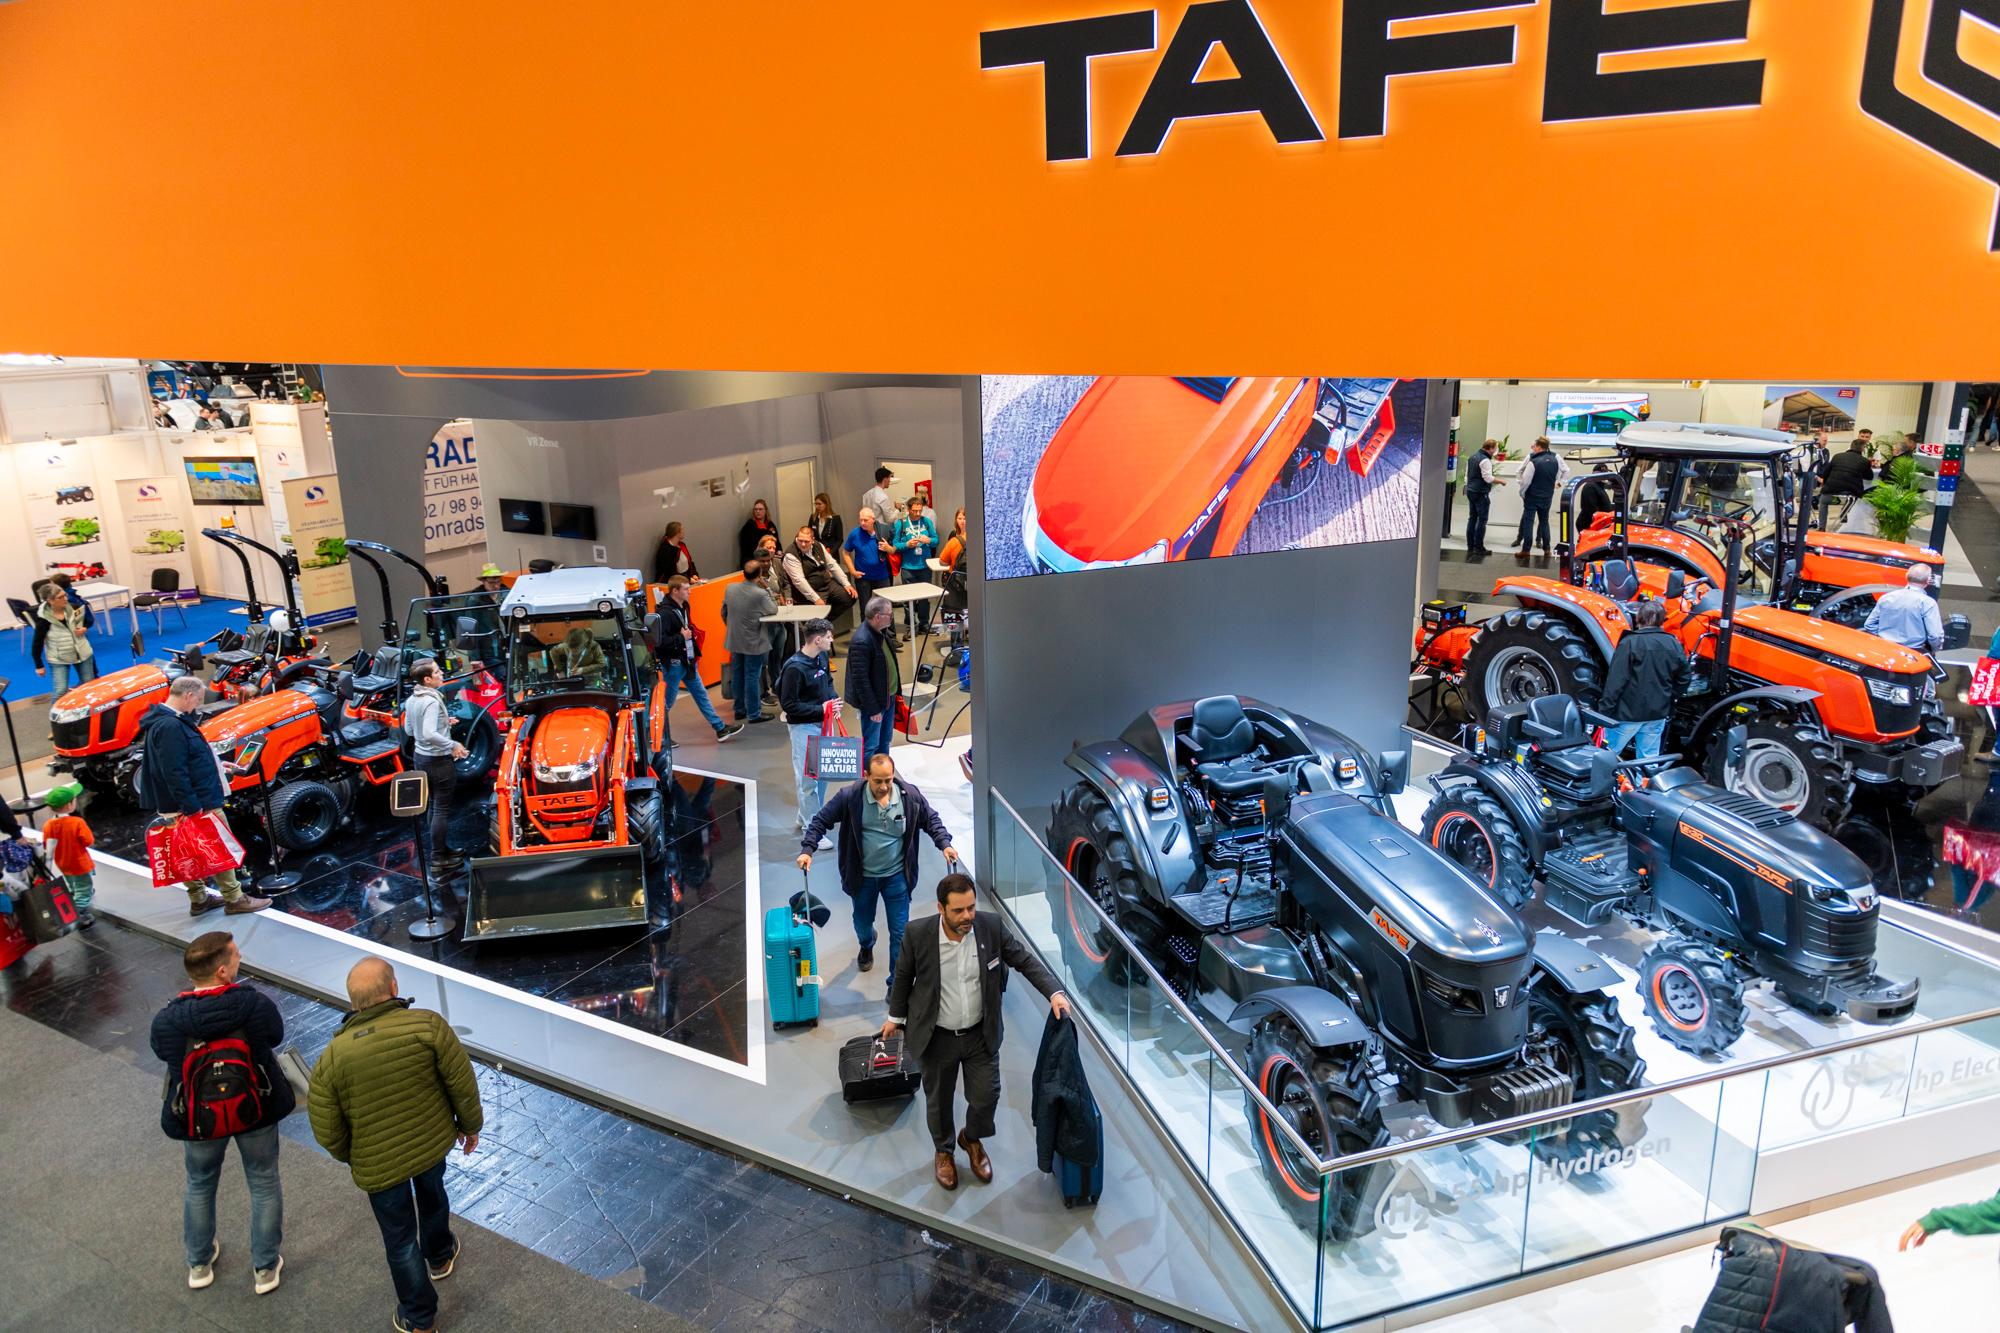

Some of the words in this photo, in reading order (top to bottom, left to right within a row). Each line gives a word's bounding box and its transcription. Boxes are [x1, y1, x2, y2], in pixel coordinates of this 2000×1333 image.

[980, 0, 1767, 162] TAFE
[539, 437, 560, 448] Zone
[434, 475, 458, 489] FÜR
[449, 498, 466, 514] 98
[470, 496, 482, 510] 9
[1183, 485, 1229, 539] TAFE
[424, 513, 485, 540] onrads
[821, 748, 857, 758] INNOVATION
[821, 764, 857, 773] NATURE
[537, 795, 587, 807] TAFE
[152, 846, 164, 860] As
[155, 860, 166, 881] One
[1756, 865, 1787, 887] TAFE
[1372, 910, 1410, 950] TAFE
[1915, 1069, 1944, 1092] hp
[1951, 1057, 2000, 1081] Elec
[1494, 1170, 1530, 1198] hp
[1537, 1136, 1671, 1185] Hydrogen
